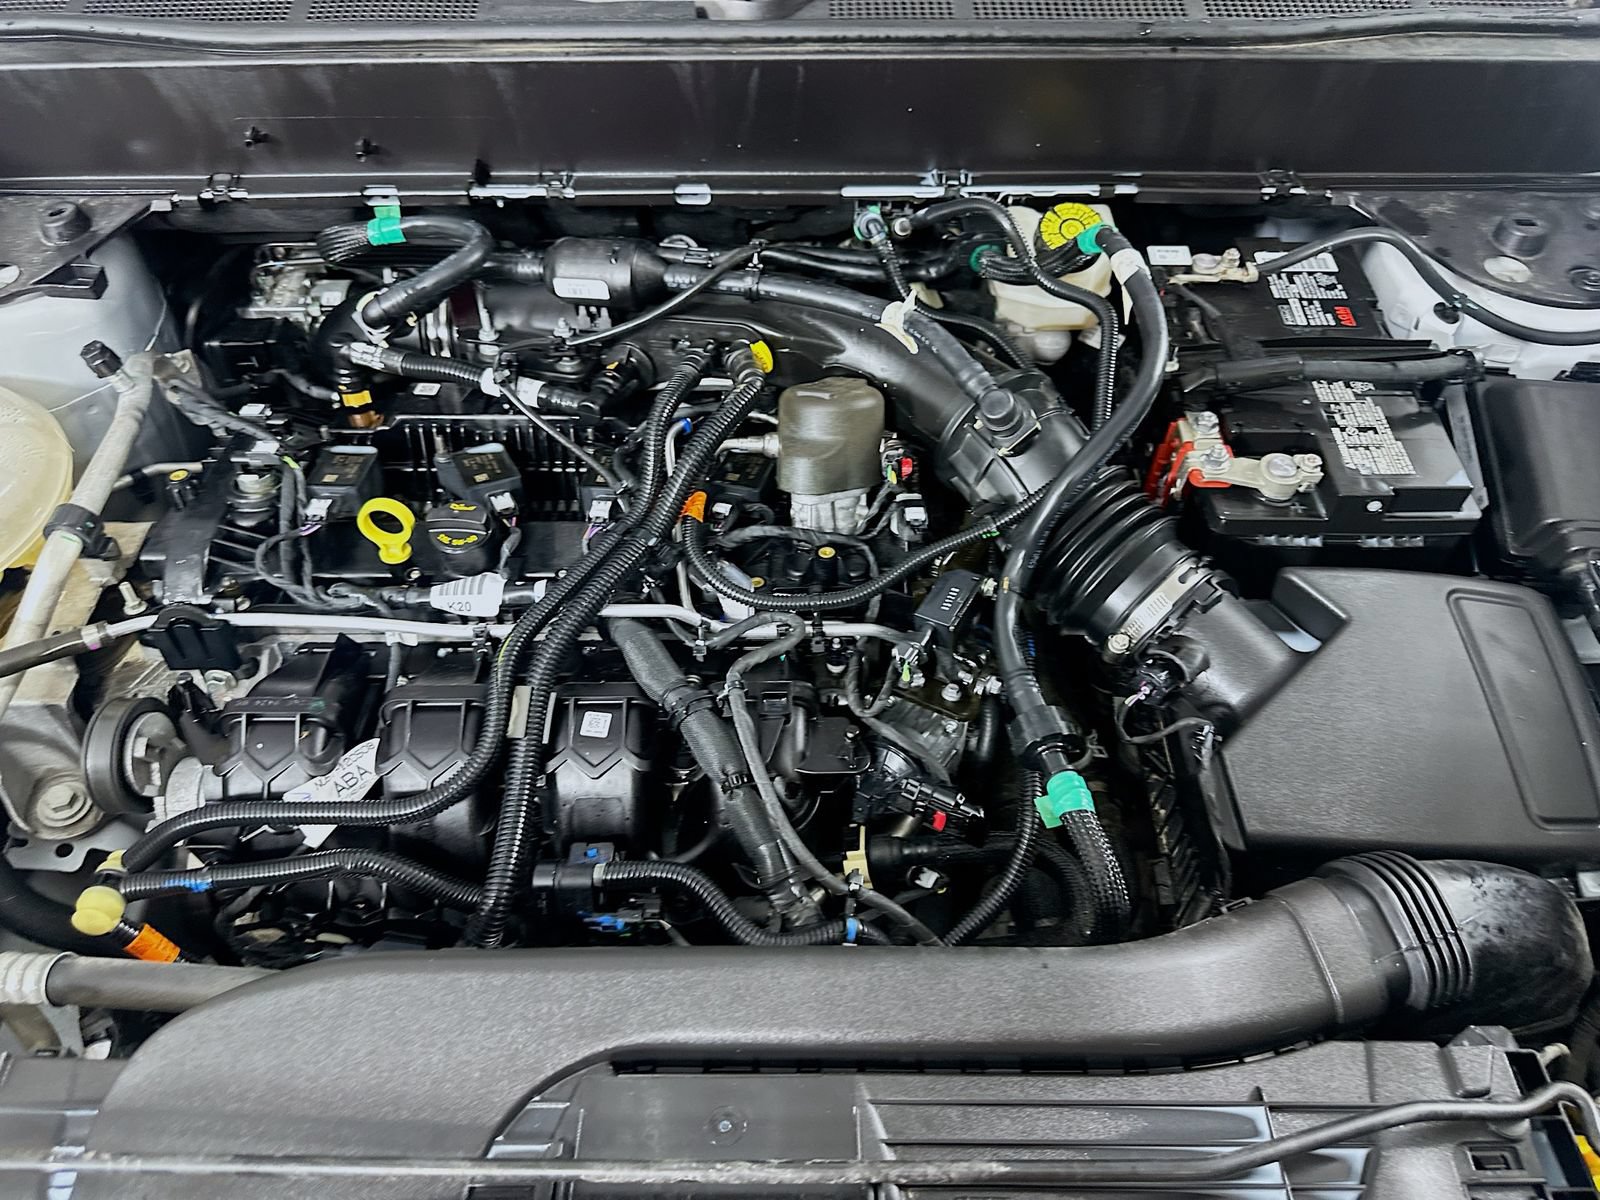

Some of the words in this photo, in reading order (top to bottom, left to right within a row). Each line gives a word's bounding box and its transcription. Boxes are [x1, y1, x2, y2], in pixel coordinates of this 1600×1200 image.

[1333, 306, 1357, 326] AGM
[447, 601, 472, 612] K20
[334, 765, 373, 798] ABA
